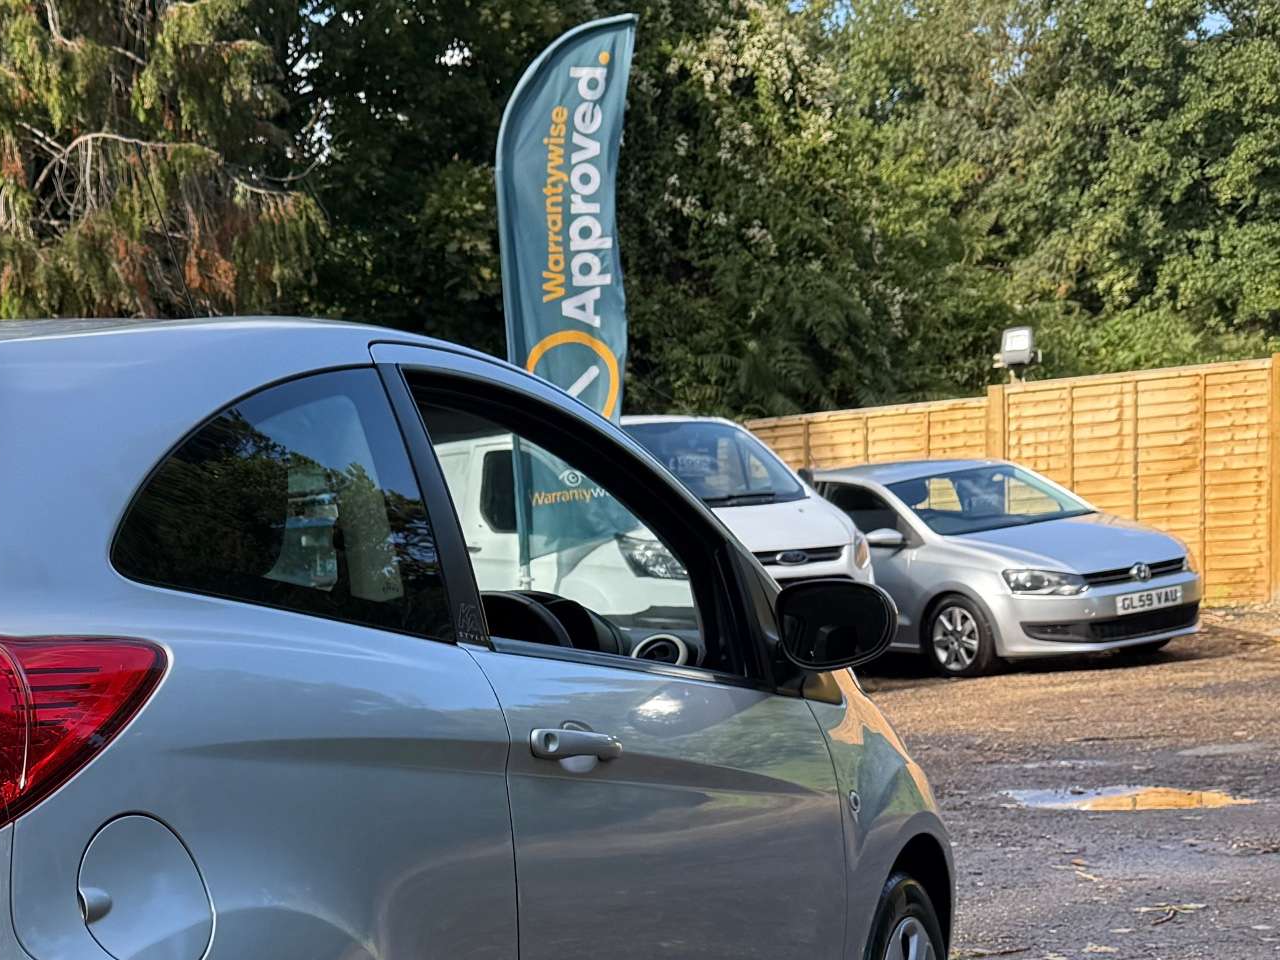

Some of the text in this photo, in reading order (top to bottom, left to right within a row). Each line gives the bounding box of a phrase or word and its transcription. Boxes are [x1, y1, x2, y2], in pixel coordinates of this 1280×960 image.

[543, 105, 569, 303] Warrantywise
[561, 51, 613, 329] Approved.
[530, 487, 611, 507] Warrantyw
[1121, 593, 1154, 611] GL59
